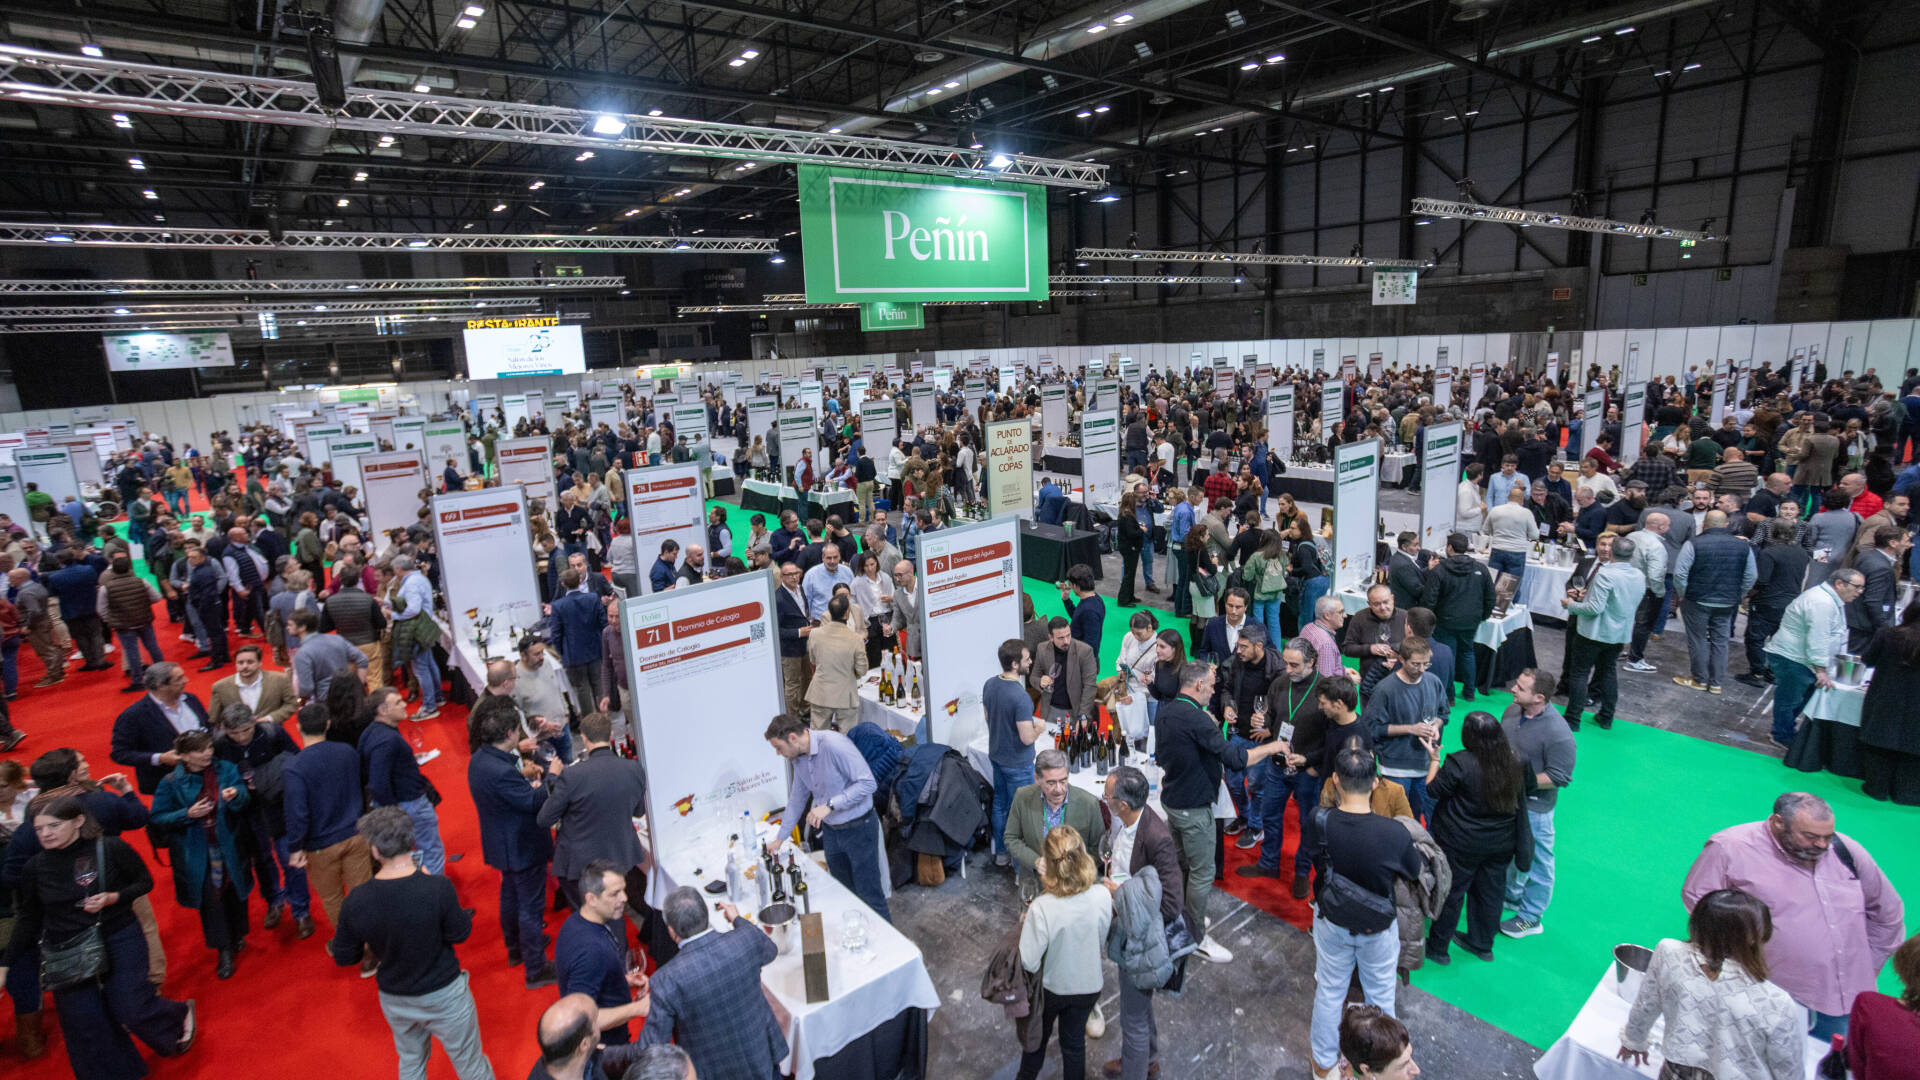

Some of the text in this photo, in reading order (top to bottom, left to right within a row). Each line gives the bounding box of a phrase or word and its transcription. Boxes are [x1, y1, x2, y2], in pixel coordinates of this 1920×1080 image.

[882, 210, 989, 261] Peñín
[879, 306, 907, 321] Peñín
[996, 428, 1022, 439] PUNTO
[990, 443, 1030, 457] ACLARADO
[998, 461, 1023, 472] COPAS
[932, 559, 944, 572] 76
[676, 620, 706, 633] Dominio
[706, 618, 715, 626] de
[646, 629, 660, 644] 71
[639, 651, 666, 664] Dominio
[667, 648, 676, 656] de
